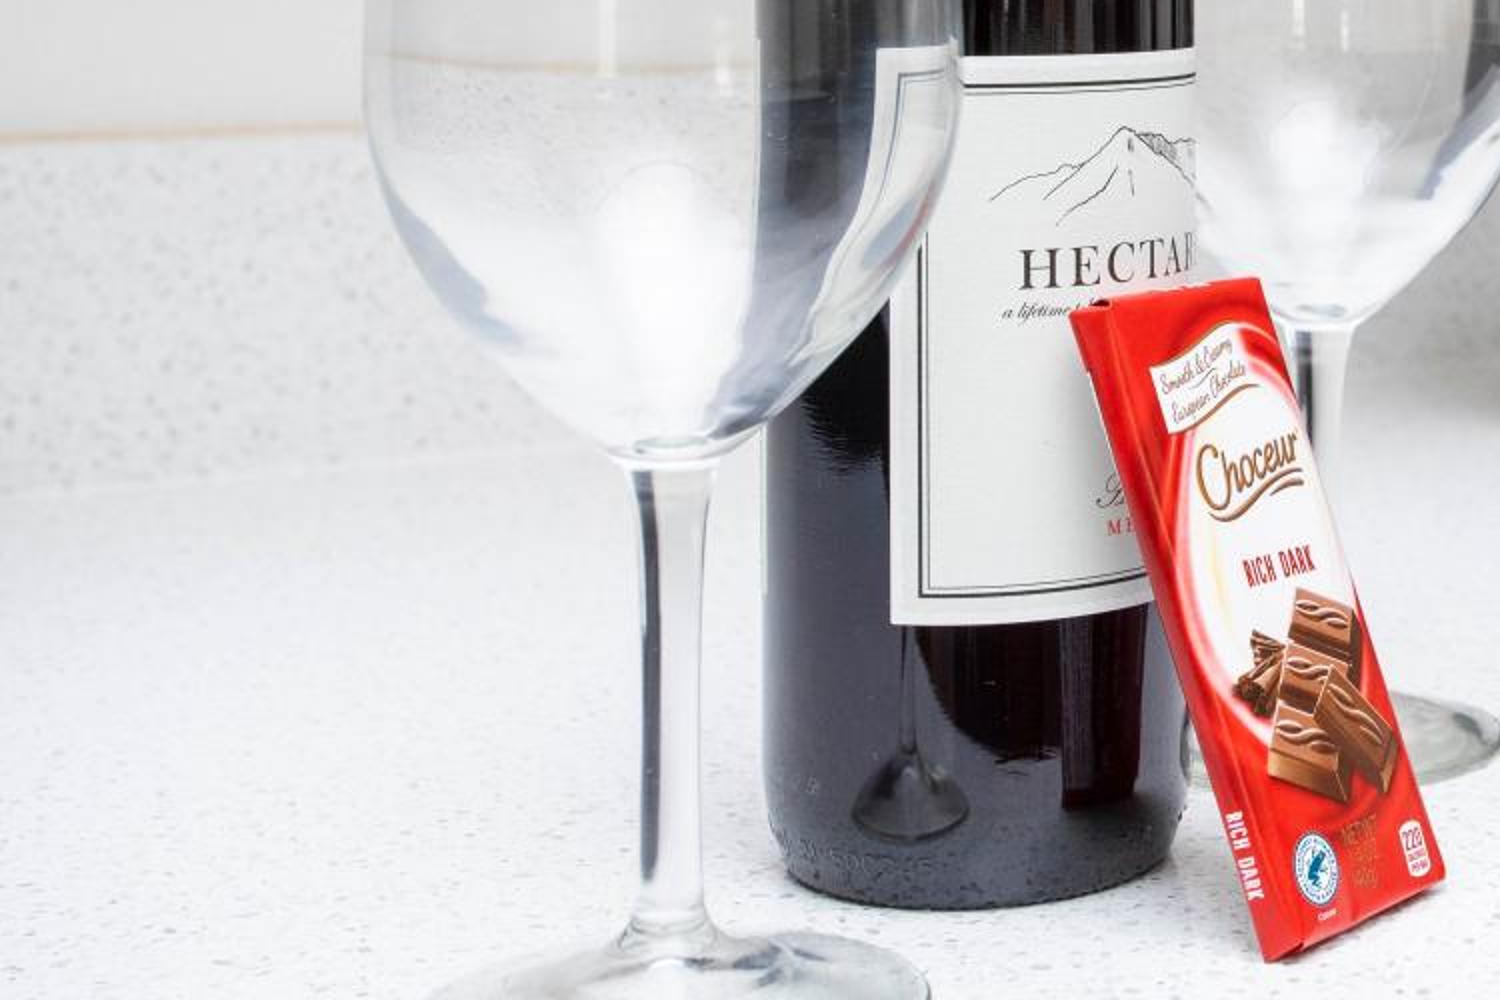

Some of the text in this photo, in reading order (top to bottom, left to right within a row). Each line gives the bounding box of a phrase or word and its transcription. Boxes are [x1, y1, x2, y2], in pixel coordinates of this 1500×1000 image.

[1160, 361, 1194, 395] Smooth
[1171, 392, 1212, 424] European
[1196, 432, 1298, 511] Choceur
[1242, 544, 1316, 588] RICH DARK
[1225, 810, 1265, 901] RICH DARK
